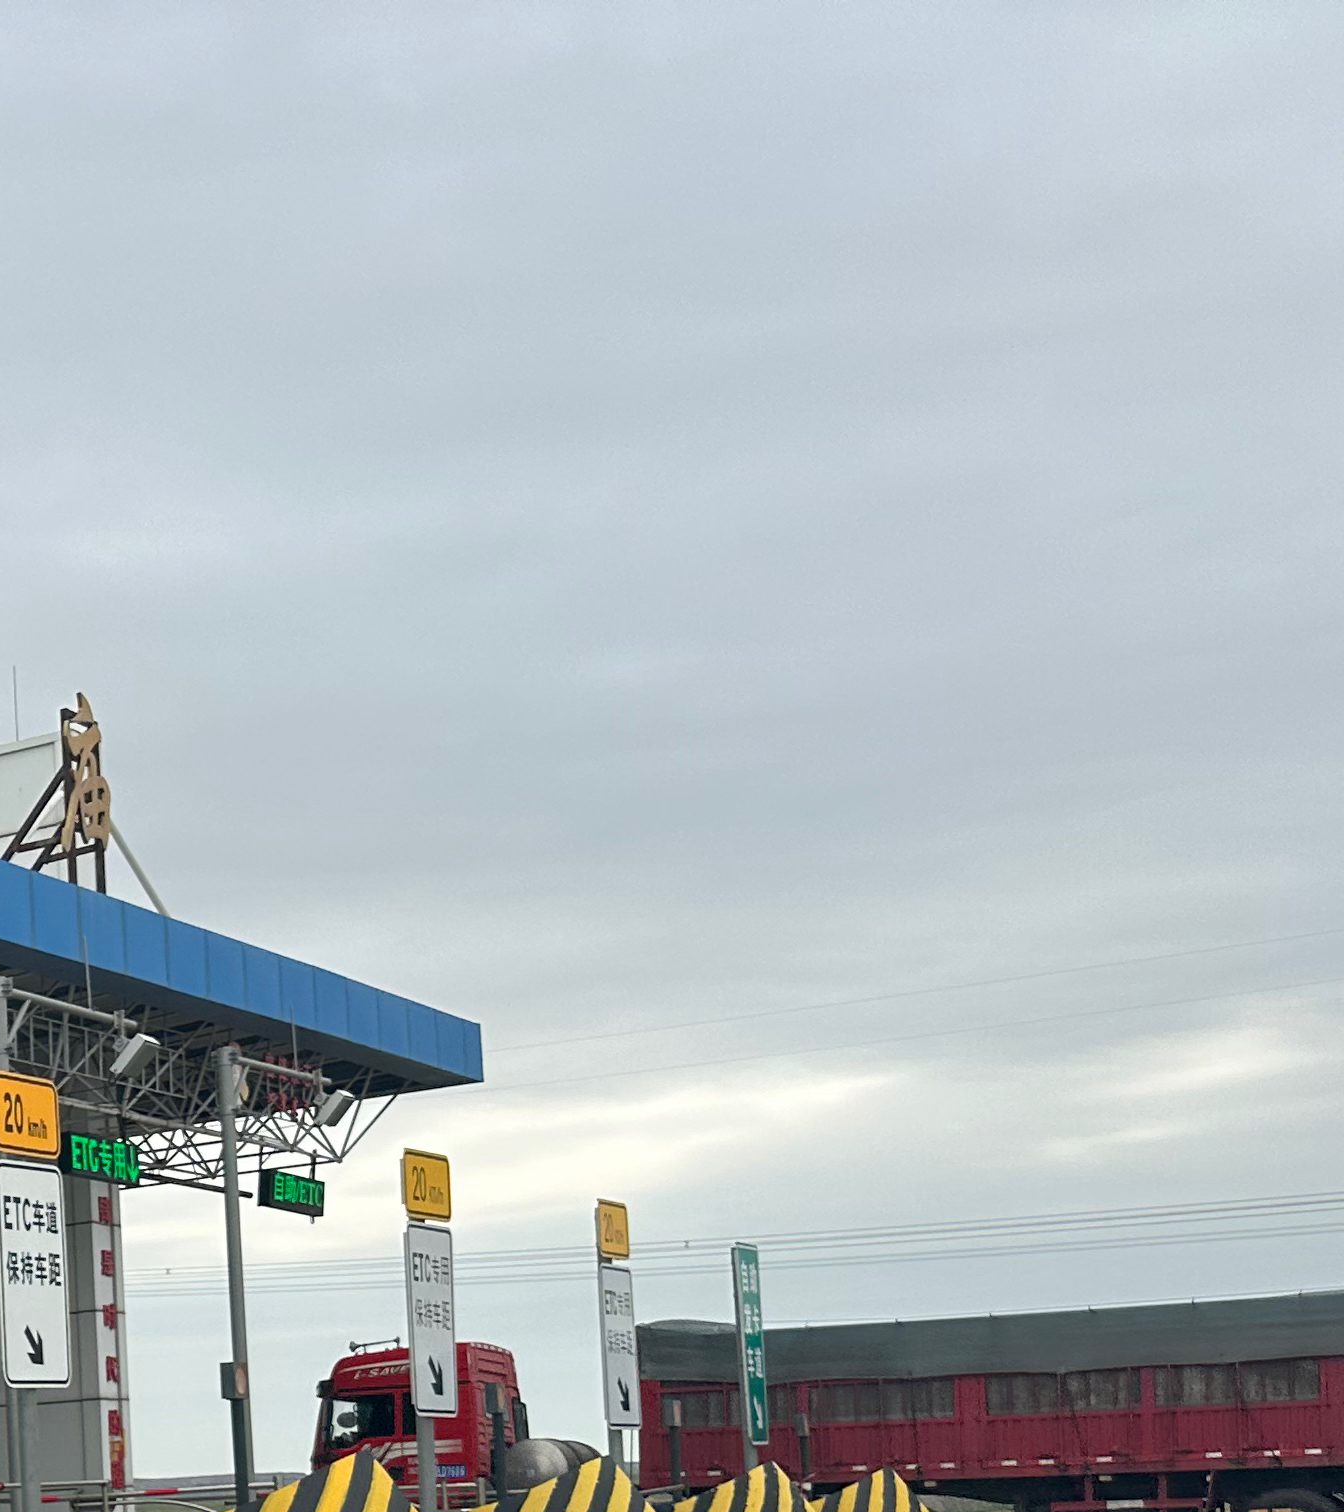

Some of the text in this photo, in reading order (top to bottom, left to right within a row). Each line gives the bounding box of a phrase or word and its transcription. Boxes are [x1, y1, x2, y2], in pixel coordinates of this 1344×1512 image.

[3, 1092, 24, 1134] 20
[70, 1134, 128, 1181] ETC专用
[412, 1166, 427, 1202] 20
[3, 1195, 59, 1235] ETC车道
[6, 1250, 62, 1287] 保持车距
[412, 1252, 450, 1286] ETC专用
